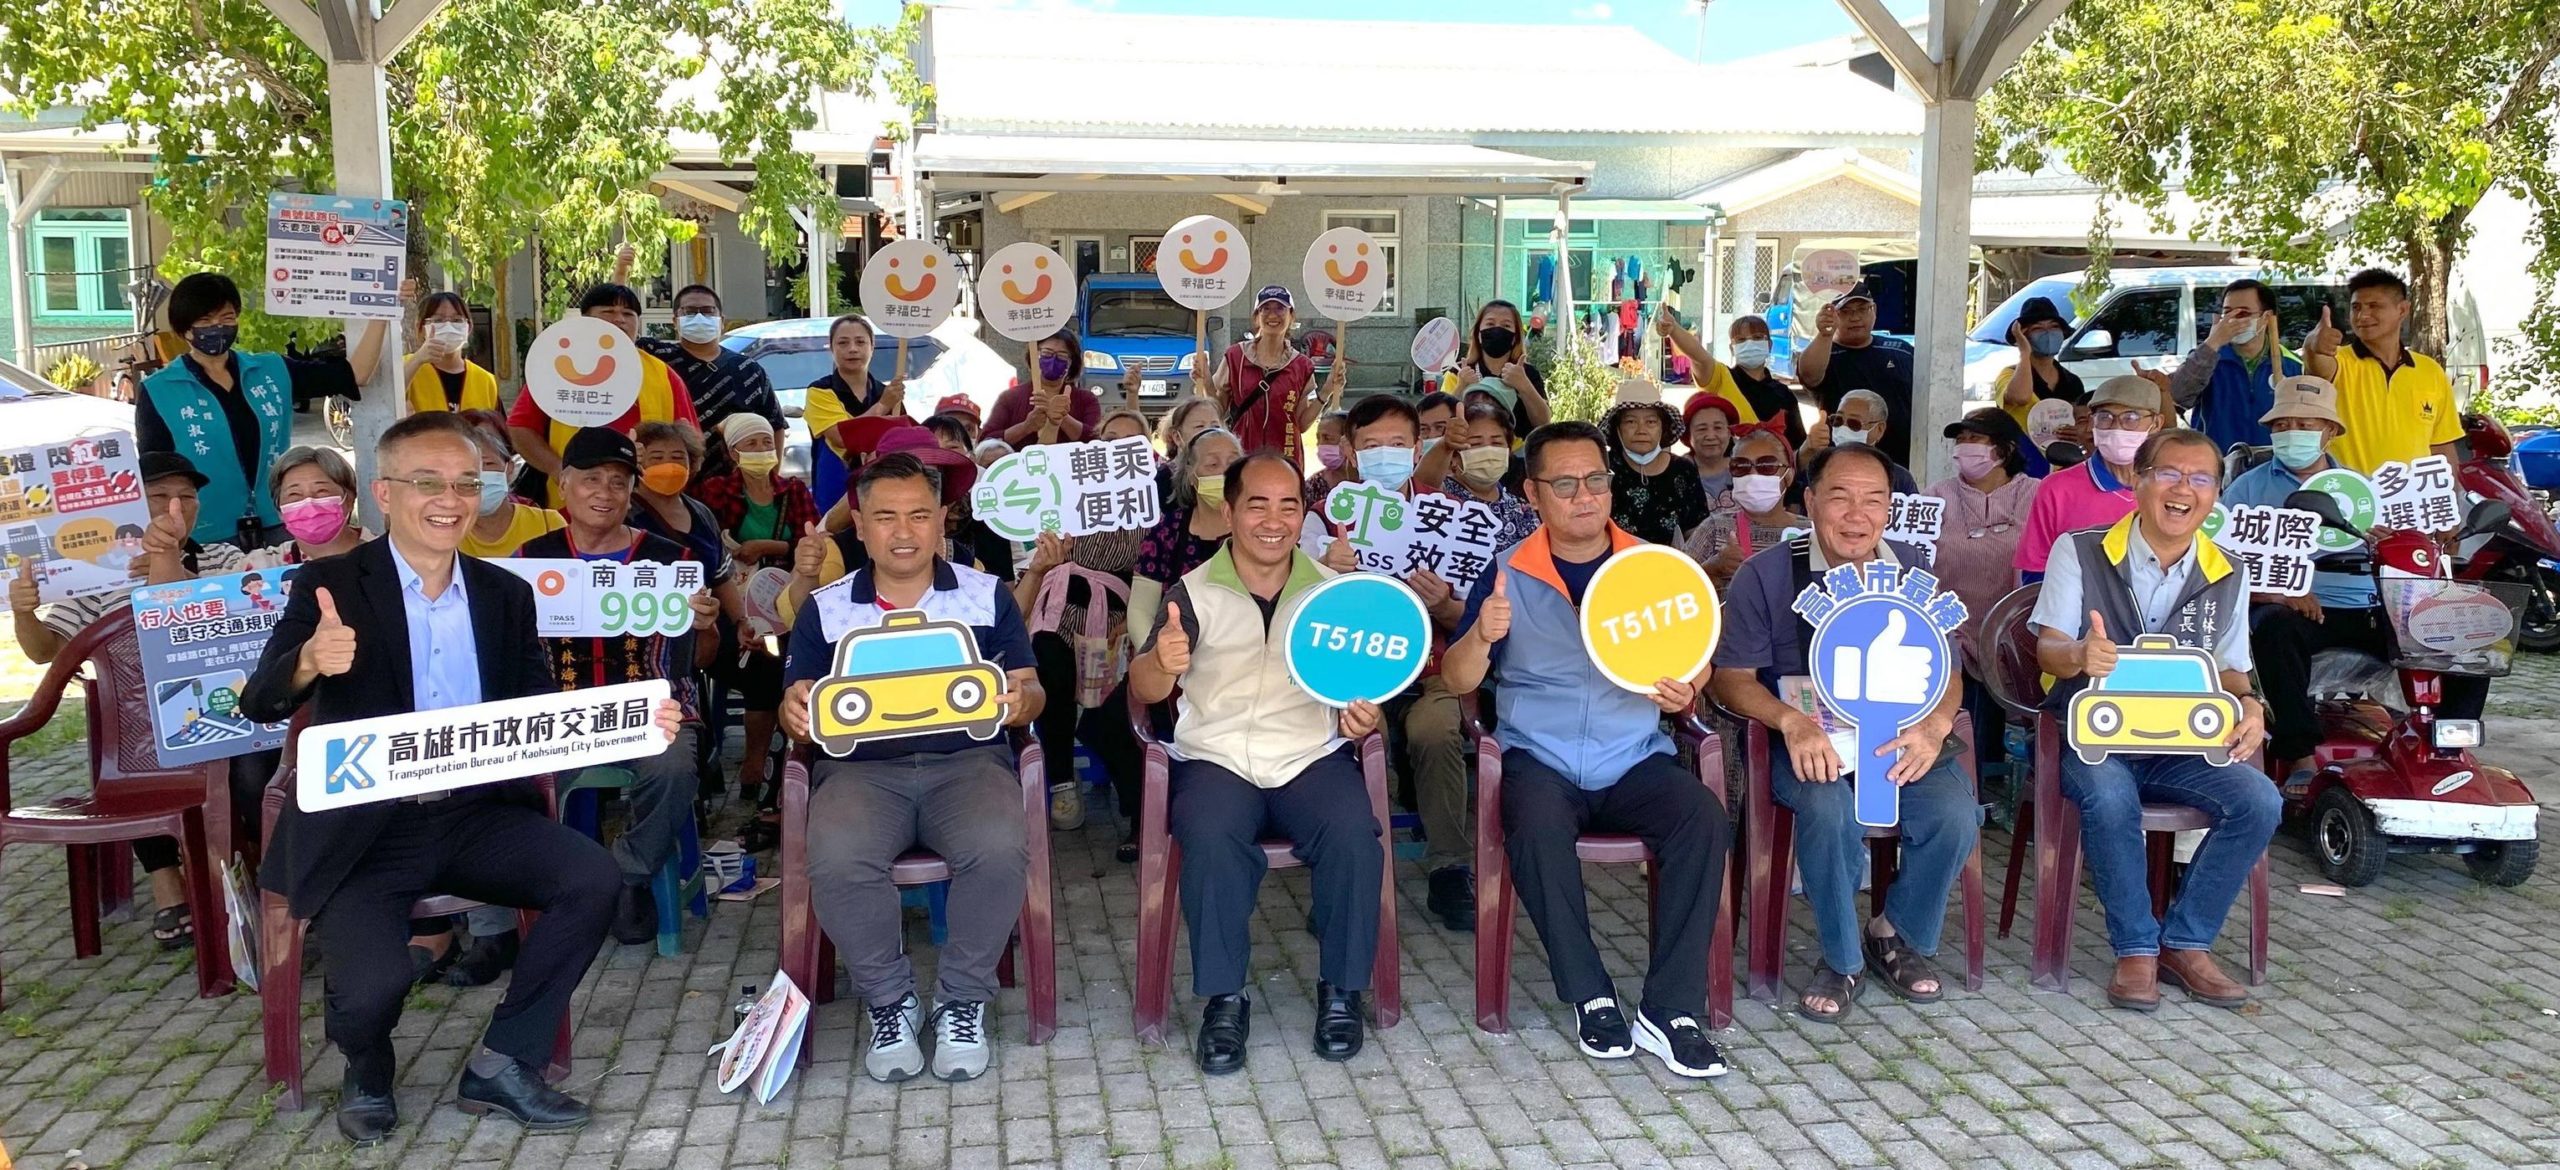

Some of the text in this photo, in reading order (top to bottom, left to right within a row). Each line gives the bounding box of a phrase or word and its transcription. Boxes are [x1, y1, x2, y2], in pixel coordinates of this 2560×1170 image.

[1181, 277, 1227, 290] 幸福巴士
[1324, 287, 1366, 302] 幸福巴士
[884, 304, 933, 319] 幸福巴士
[1007, 306, 1055, 321] 幸福巴士
[556, 389, 614, 405] 幸福巴士
[1283, 390, 1297, 457] 高雄區監理
[47, 438, 121, 468] 閃紅燈
[1069, 440, 1150, 486] 轉乘
[51, 464, 106, 487] 要停車
[2377, 459, 2449, 499] 多元
[1075, 485, 1155, 530] 便利
[1414, 499, 1496, 548] 安全
[2382, 494, 2456, 532] 選擇
[2231, 508, 2316, 550] 城際
[592, 565, 699, 589] 南高屏
[1402, 540, 1488, 588] 效率
[140, 600, 226, 628] 行人也要
[600, 591, 689, 632] 999
[1793, 561, 1967, 631] 高雄市最棒
[171, 612, 279, 643] 遵守交通規則
[1601, 592, 1700, 645] T517B
[2202, 599, 2217, 650] 杉林區
[1310, 621, 1409, 661] T518B
[388, 697, 649, 766] 高雄市政府交通局
[388, 731, 647, 781] Transportation Bureau of Kaohsiung City Government
[1583, 997, 1616, 1015] PUMA
